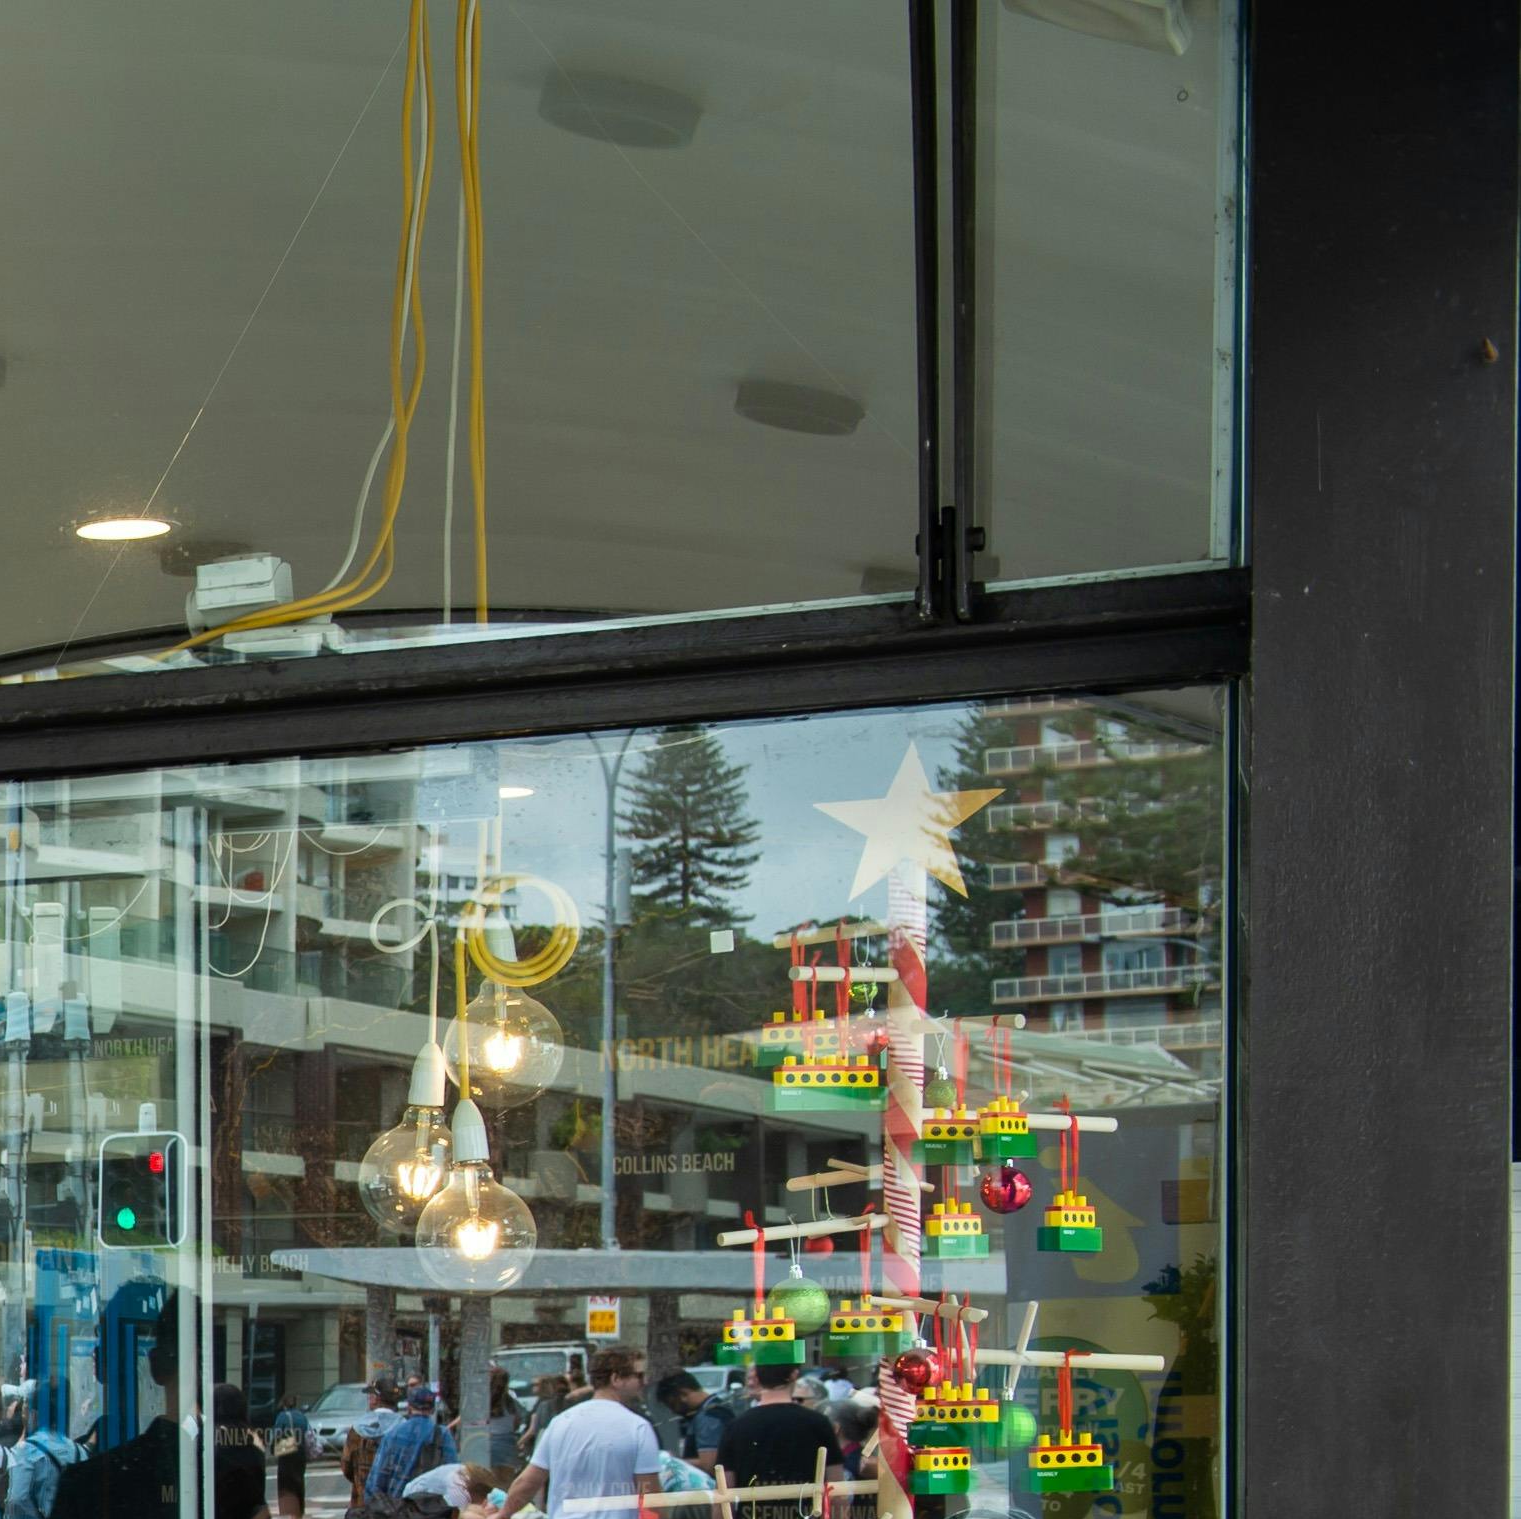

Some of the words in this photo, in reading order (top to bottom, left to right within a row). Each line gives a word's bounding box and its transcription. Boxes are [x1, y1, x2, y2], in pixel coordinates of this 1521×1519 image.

[146, 1037, 174, 1056] HEA
[701, 1033, 758, 1067] HEA
[613, 1155, 677, 1175] COLLINS
[682, 1152, 735, 1173] BEACH
[213, 1256, 256, 1273] HELLY
[261, 1254, 309, 1272] BEACH
[214, 1429, 248, 1447] ANLY
